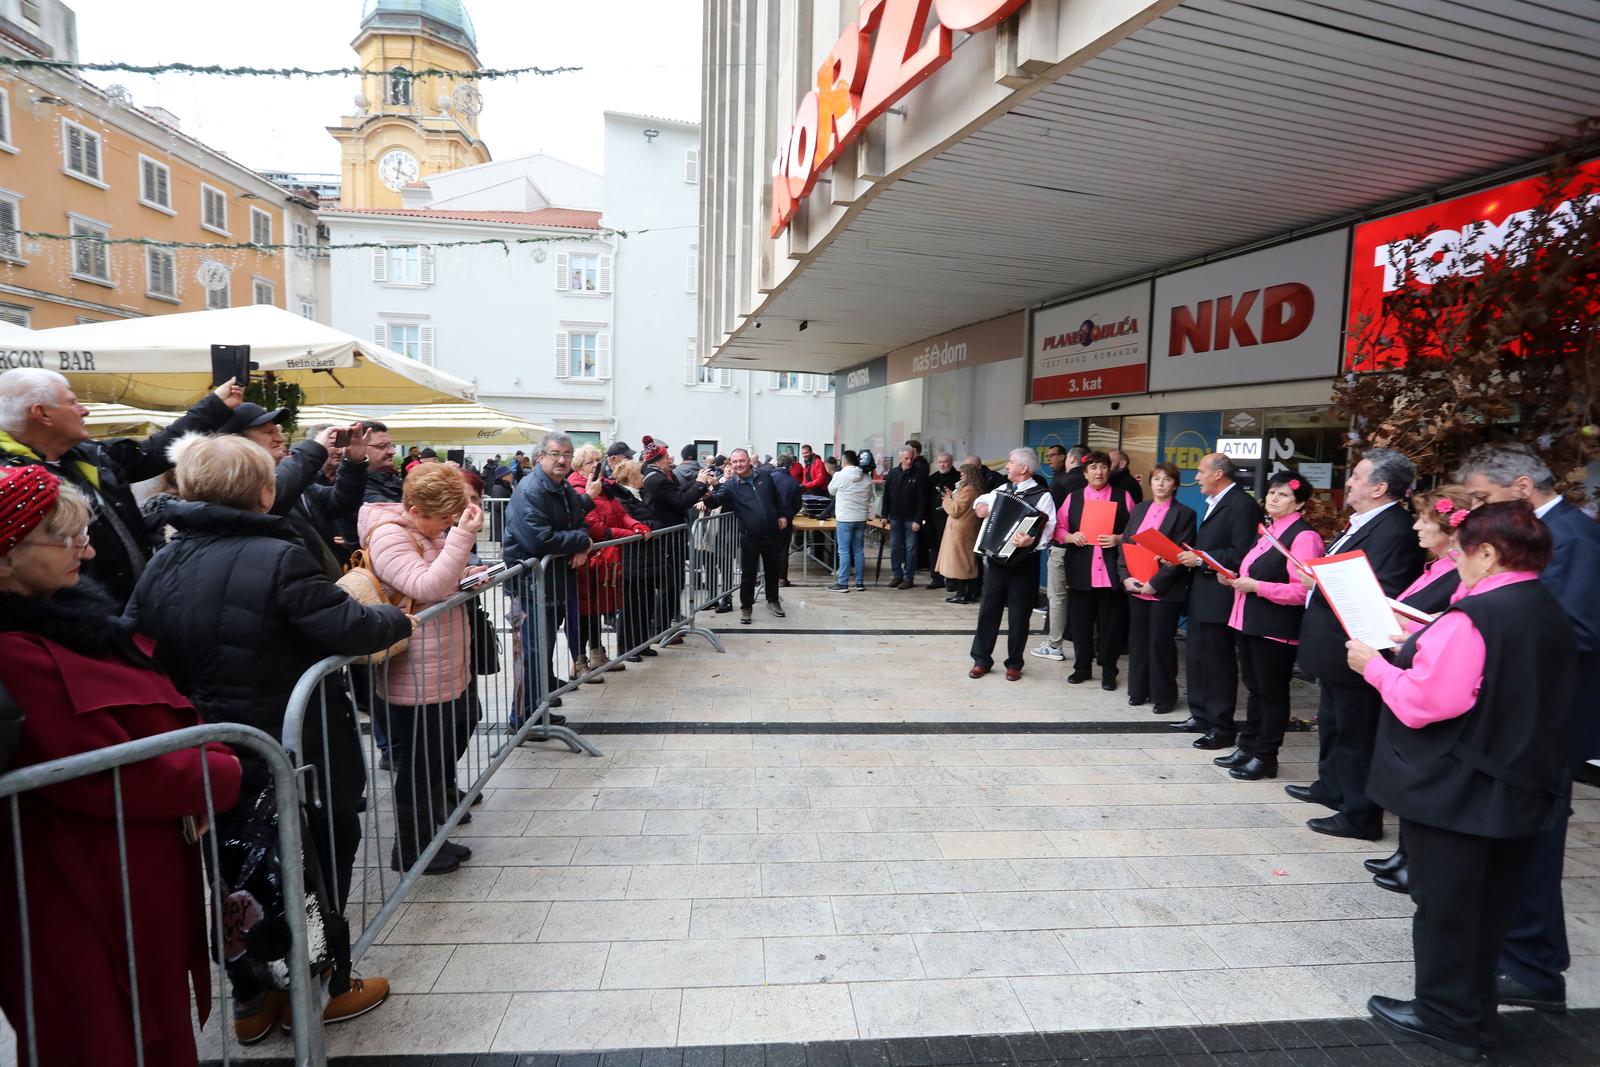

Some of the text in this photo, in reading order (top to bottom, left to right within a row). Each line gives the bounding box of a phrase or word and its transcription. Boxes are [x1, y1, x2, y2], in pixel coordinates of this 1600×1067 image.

[771, 0, 1026, 239] KORZ
[1374, 193, 1600, 293] TOM
[1168, 282, 1315, 357] NKD
[59, 351, 96, 371] BAR
[286, 358, 336, 368] Heineken
[912, 341, 967, 373] naš dom
[1068, 376, 1102, 393] 3. kat
[1164, 447, 1211, 469] TED
[1222, 442, 1258, 455] ATM
